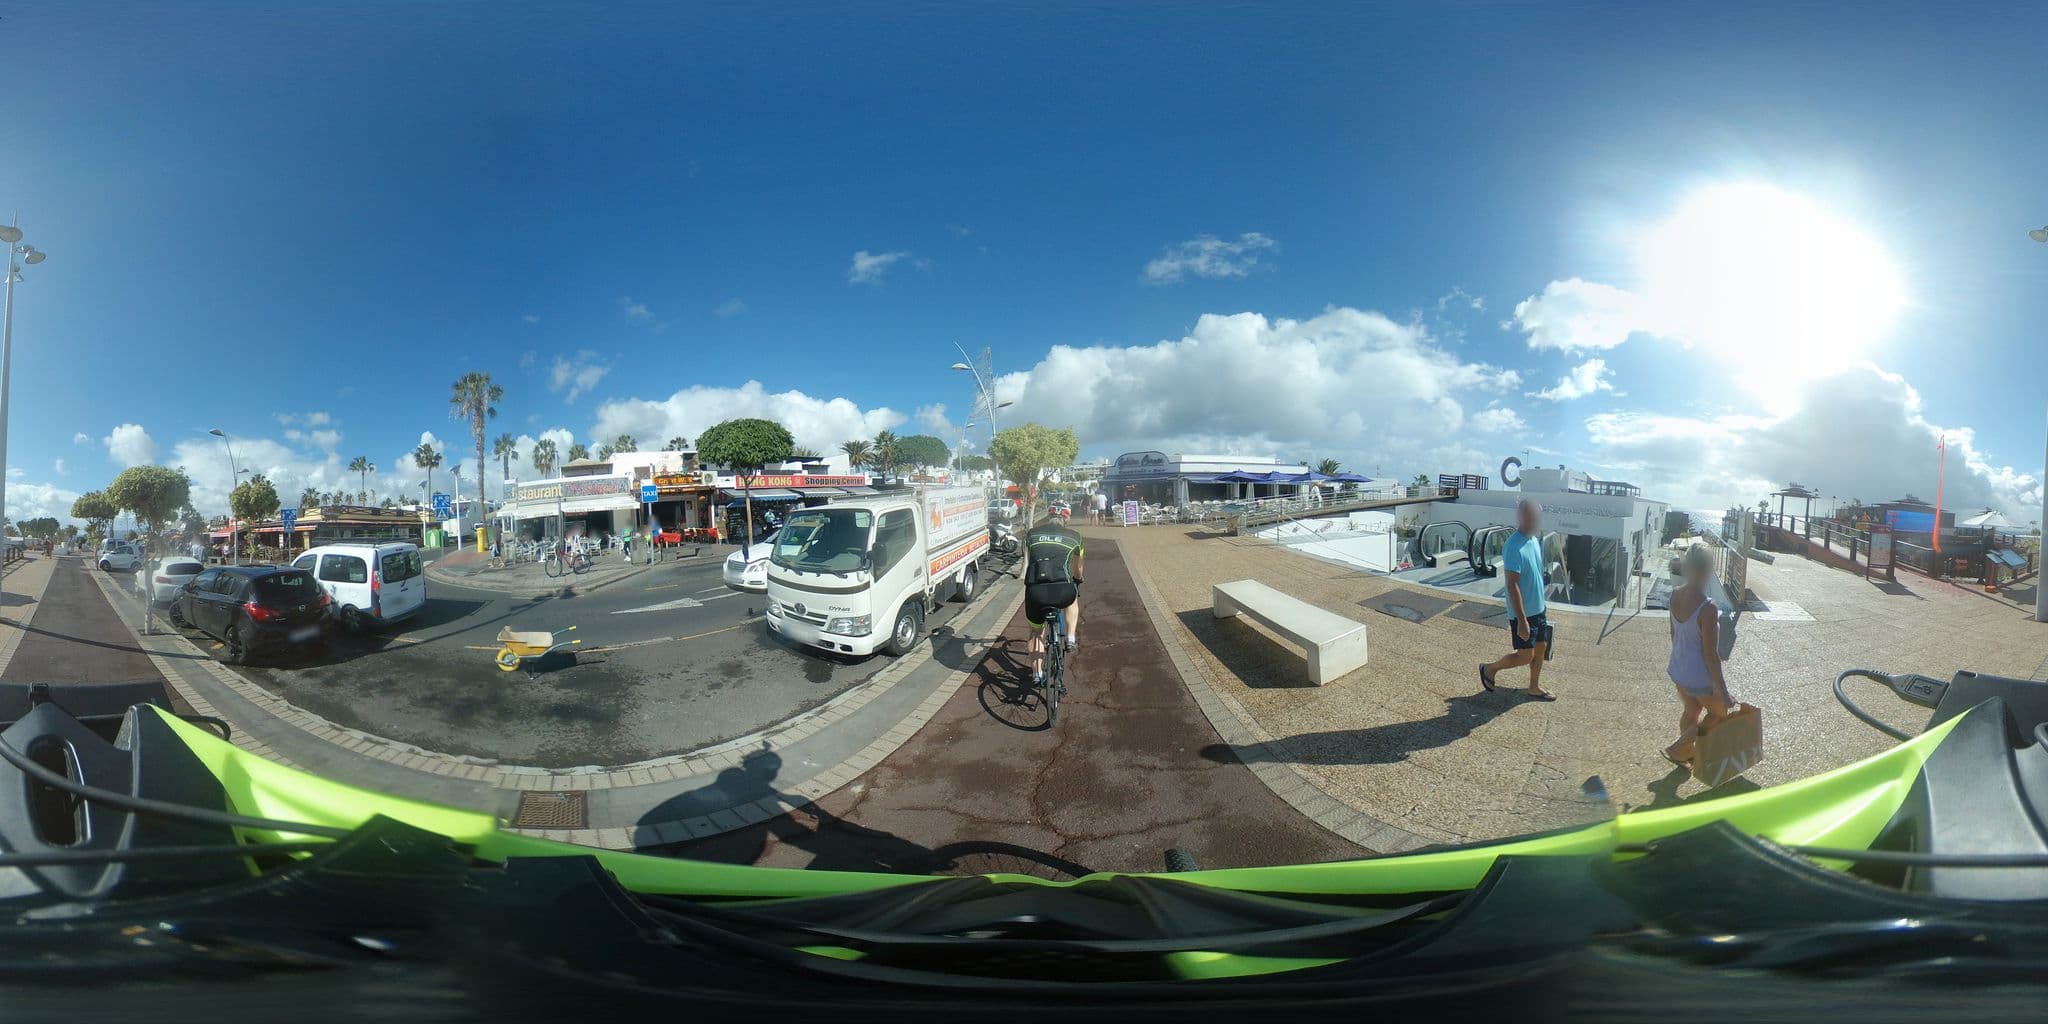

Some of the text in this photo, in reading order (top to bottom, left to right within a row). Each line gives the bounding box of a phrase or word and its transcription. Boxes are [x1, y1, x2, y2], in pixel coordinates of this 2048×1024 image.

[768, 475, 793, 487] KONG
[804, 476, 841, 487] Shopping
[512, 484, 562, 500] staurant
